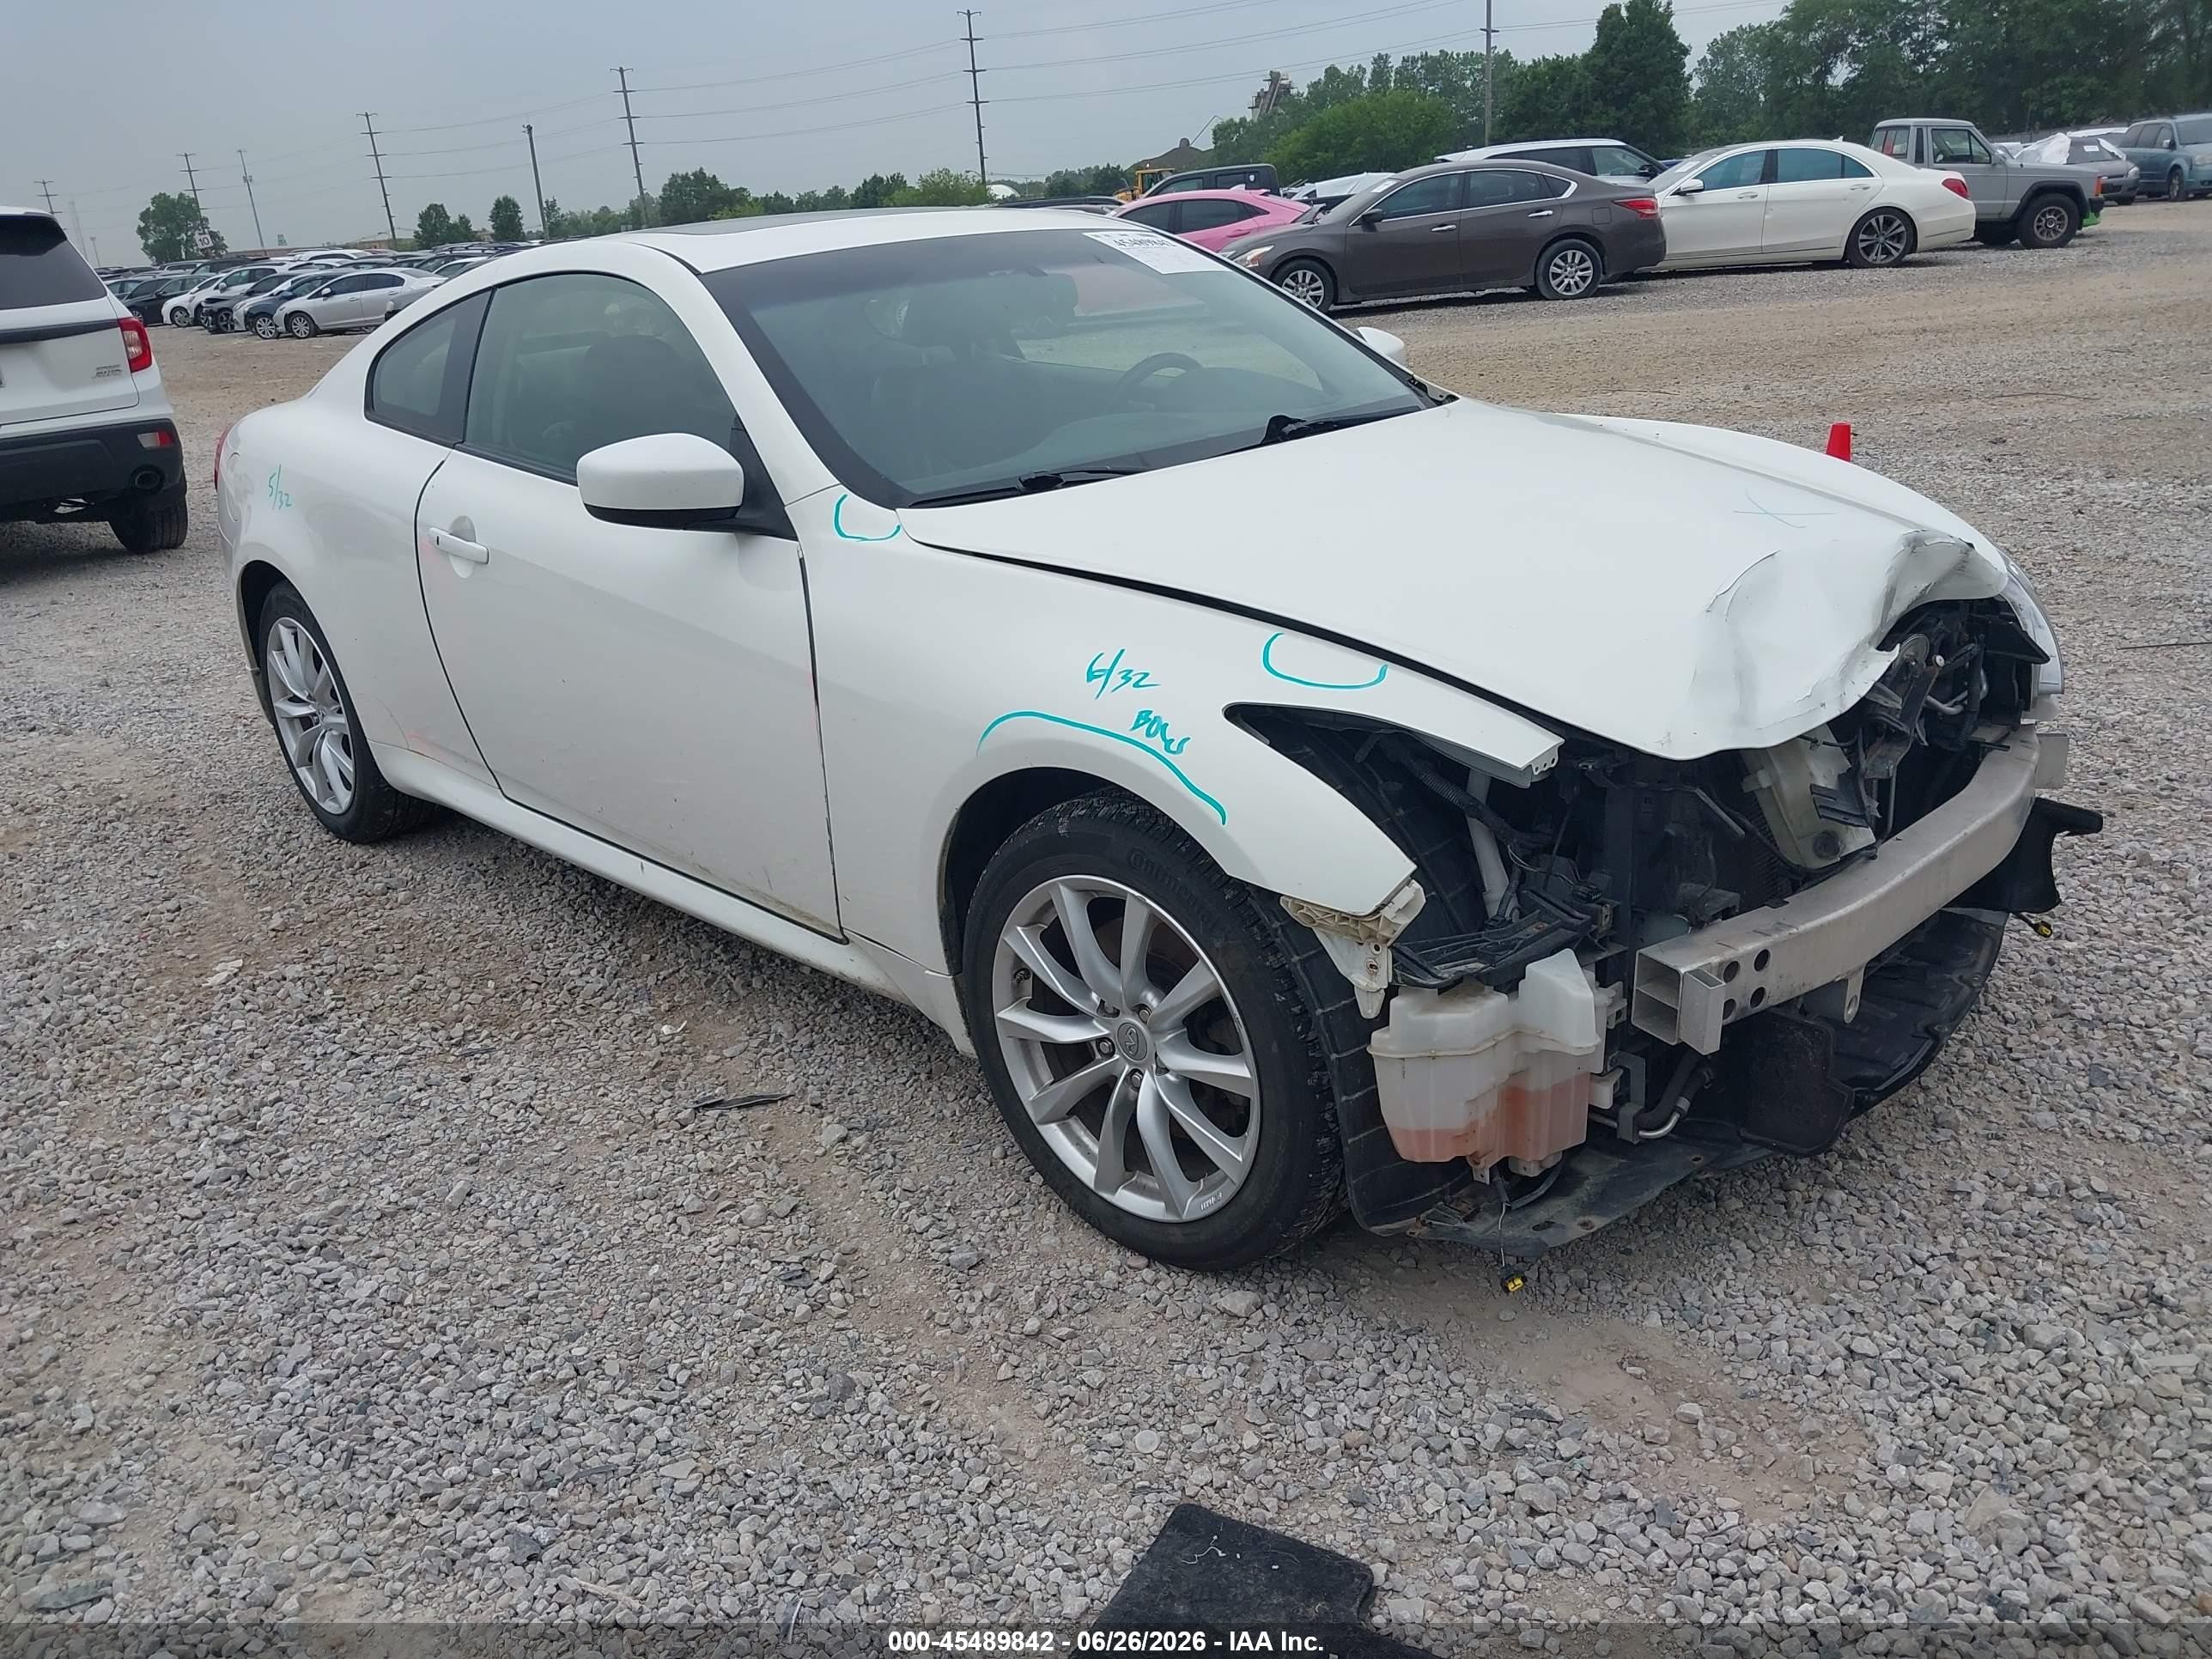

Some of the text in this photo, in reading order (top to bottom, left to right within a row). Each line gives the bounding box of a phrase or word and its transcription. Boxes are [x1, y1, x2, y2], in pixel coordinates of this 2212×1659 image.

[198, 236, 210, 246] 10
[268, 463, 293, 511] 5/32
[1085, 648, 1161, 700] 6/32
